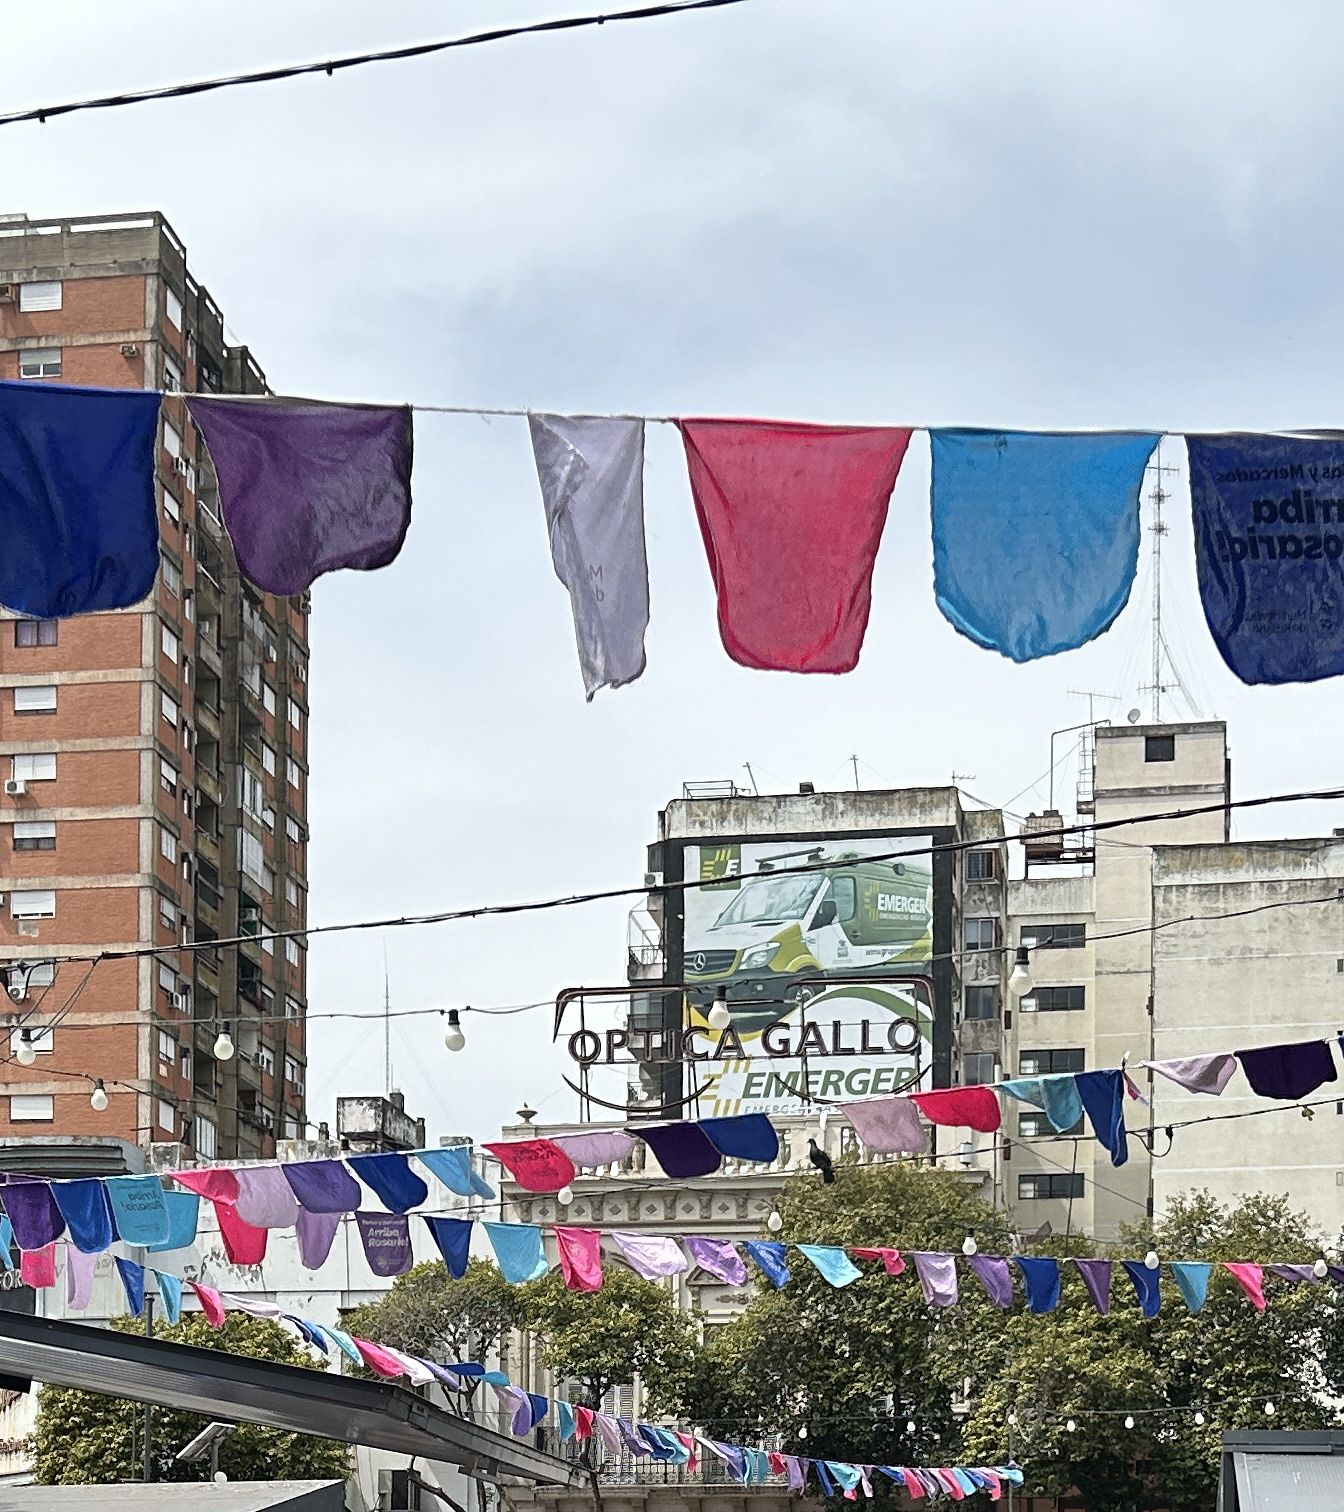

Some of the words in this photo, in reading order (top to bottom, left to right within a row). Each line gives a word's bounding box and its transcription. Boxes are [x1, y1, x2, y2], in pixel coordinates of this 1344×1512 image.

[877, 894, 927, 914] EMERGER
[568, 1025, 745, 1064] OPTICA
[761, 1017, 921, 1057] GALLO
